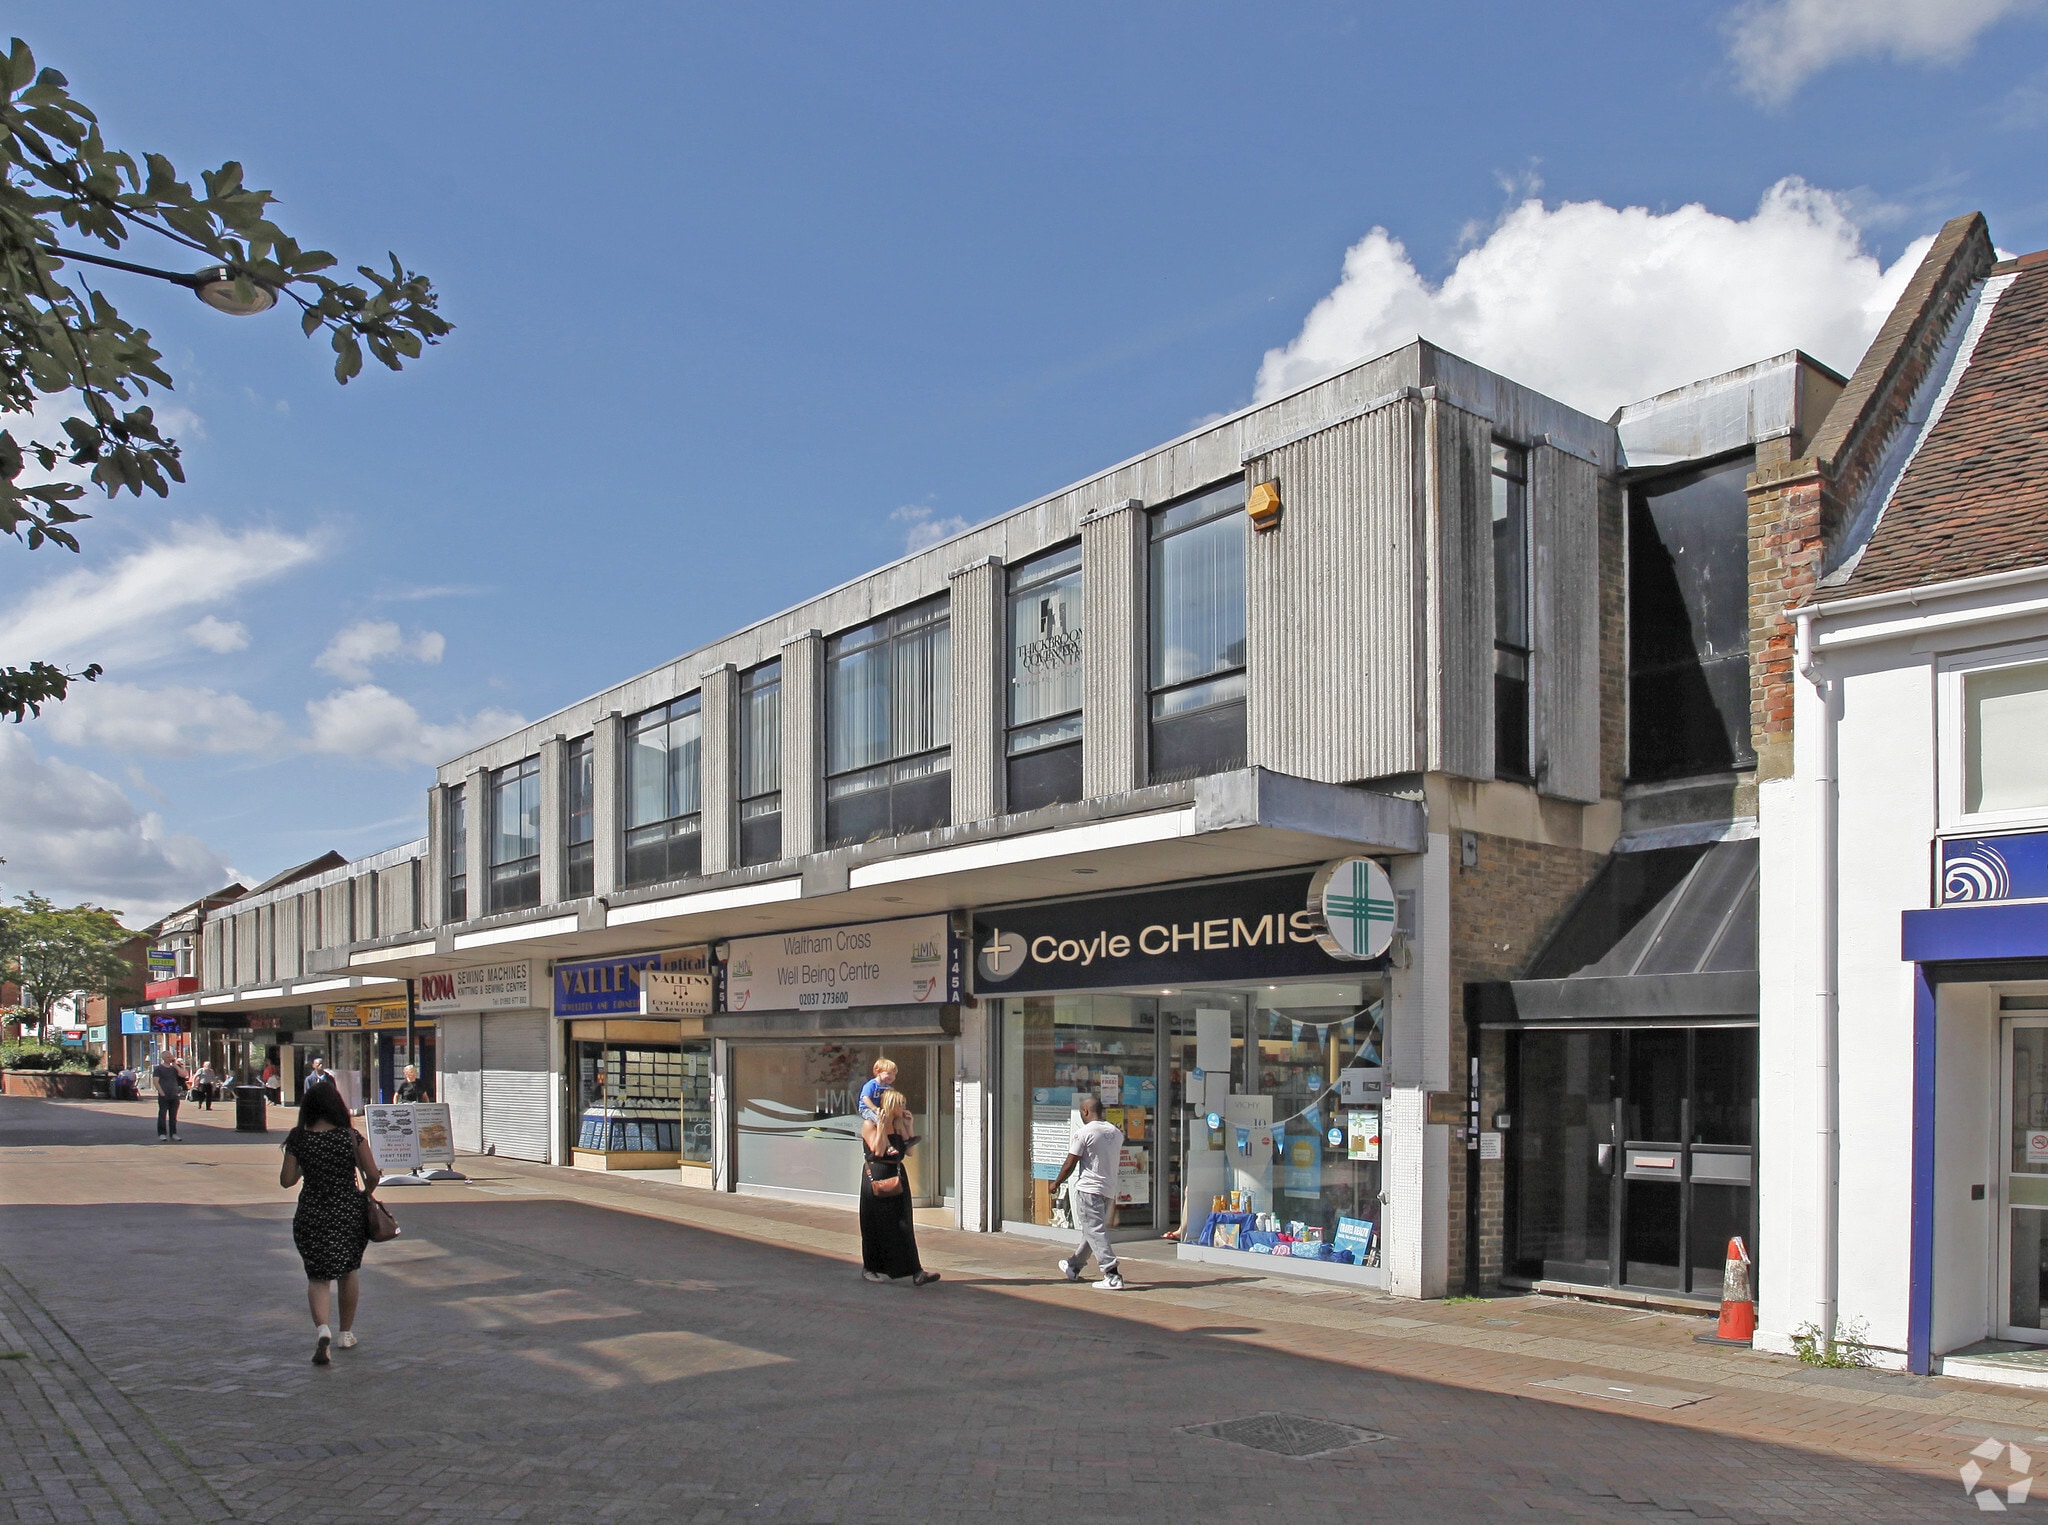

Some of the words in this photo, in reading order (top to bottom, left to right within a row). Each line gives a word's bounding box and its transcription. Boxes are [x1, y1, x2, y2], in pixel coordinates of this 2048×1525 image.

[1017, 628, 1082, 657] THICKBROO
[784, 936, 832, 955] Waltham
[837, 931, 871, 951] Cross
[1031, 931, 1131, 966] Coyle
[1139, 911, 1316, 955] CHEMIS
[458, 970, 484, 984] SEWING
[488, 964, 527, 981] MACHINES
[652, 975, 709, 985] VALLENS
[778, 967, 798, 985] Well
[802, 965, 835, 987] Being
[839, 961, 879, 981] Centre
[421, 974, 456, 1002] RONA
[485, 983, 504, 993] SEWING
[506, 981, 527, 992] CENTRE
[799, 993, 819, 1005] 02037
[822, 992, 848, 1004] 273600
